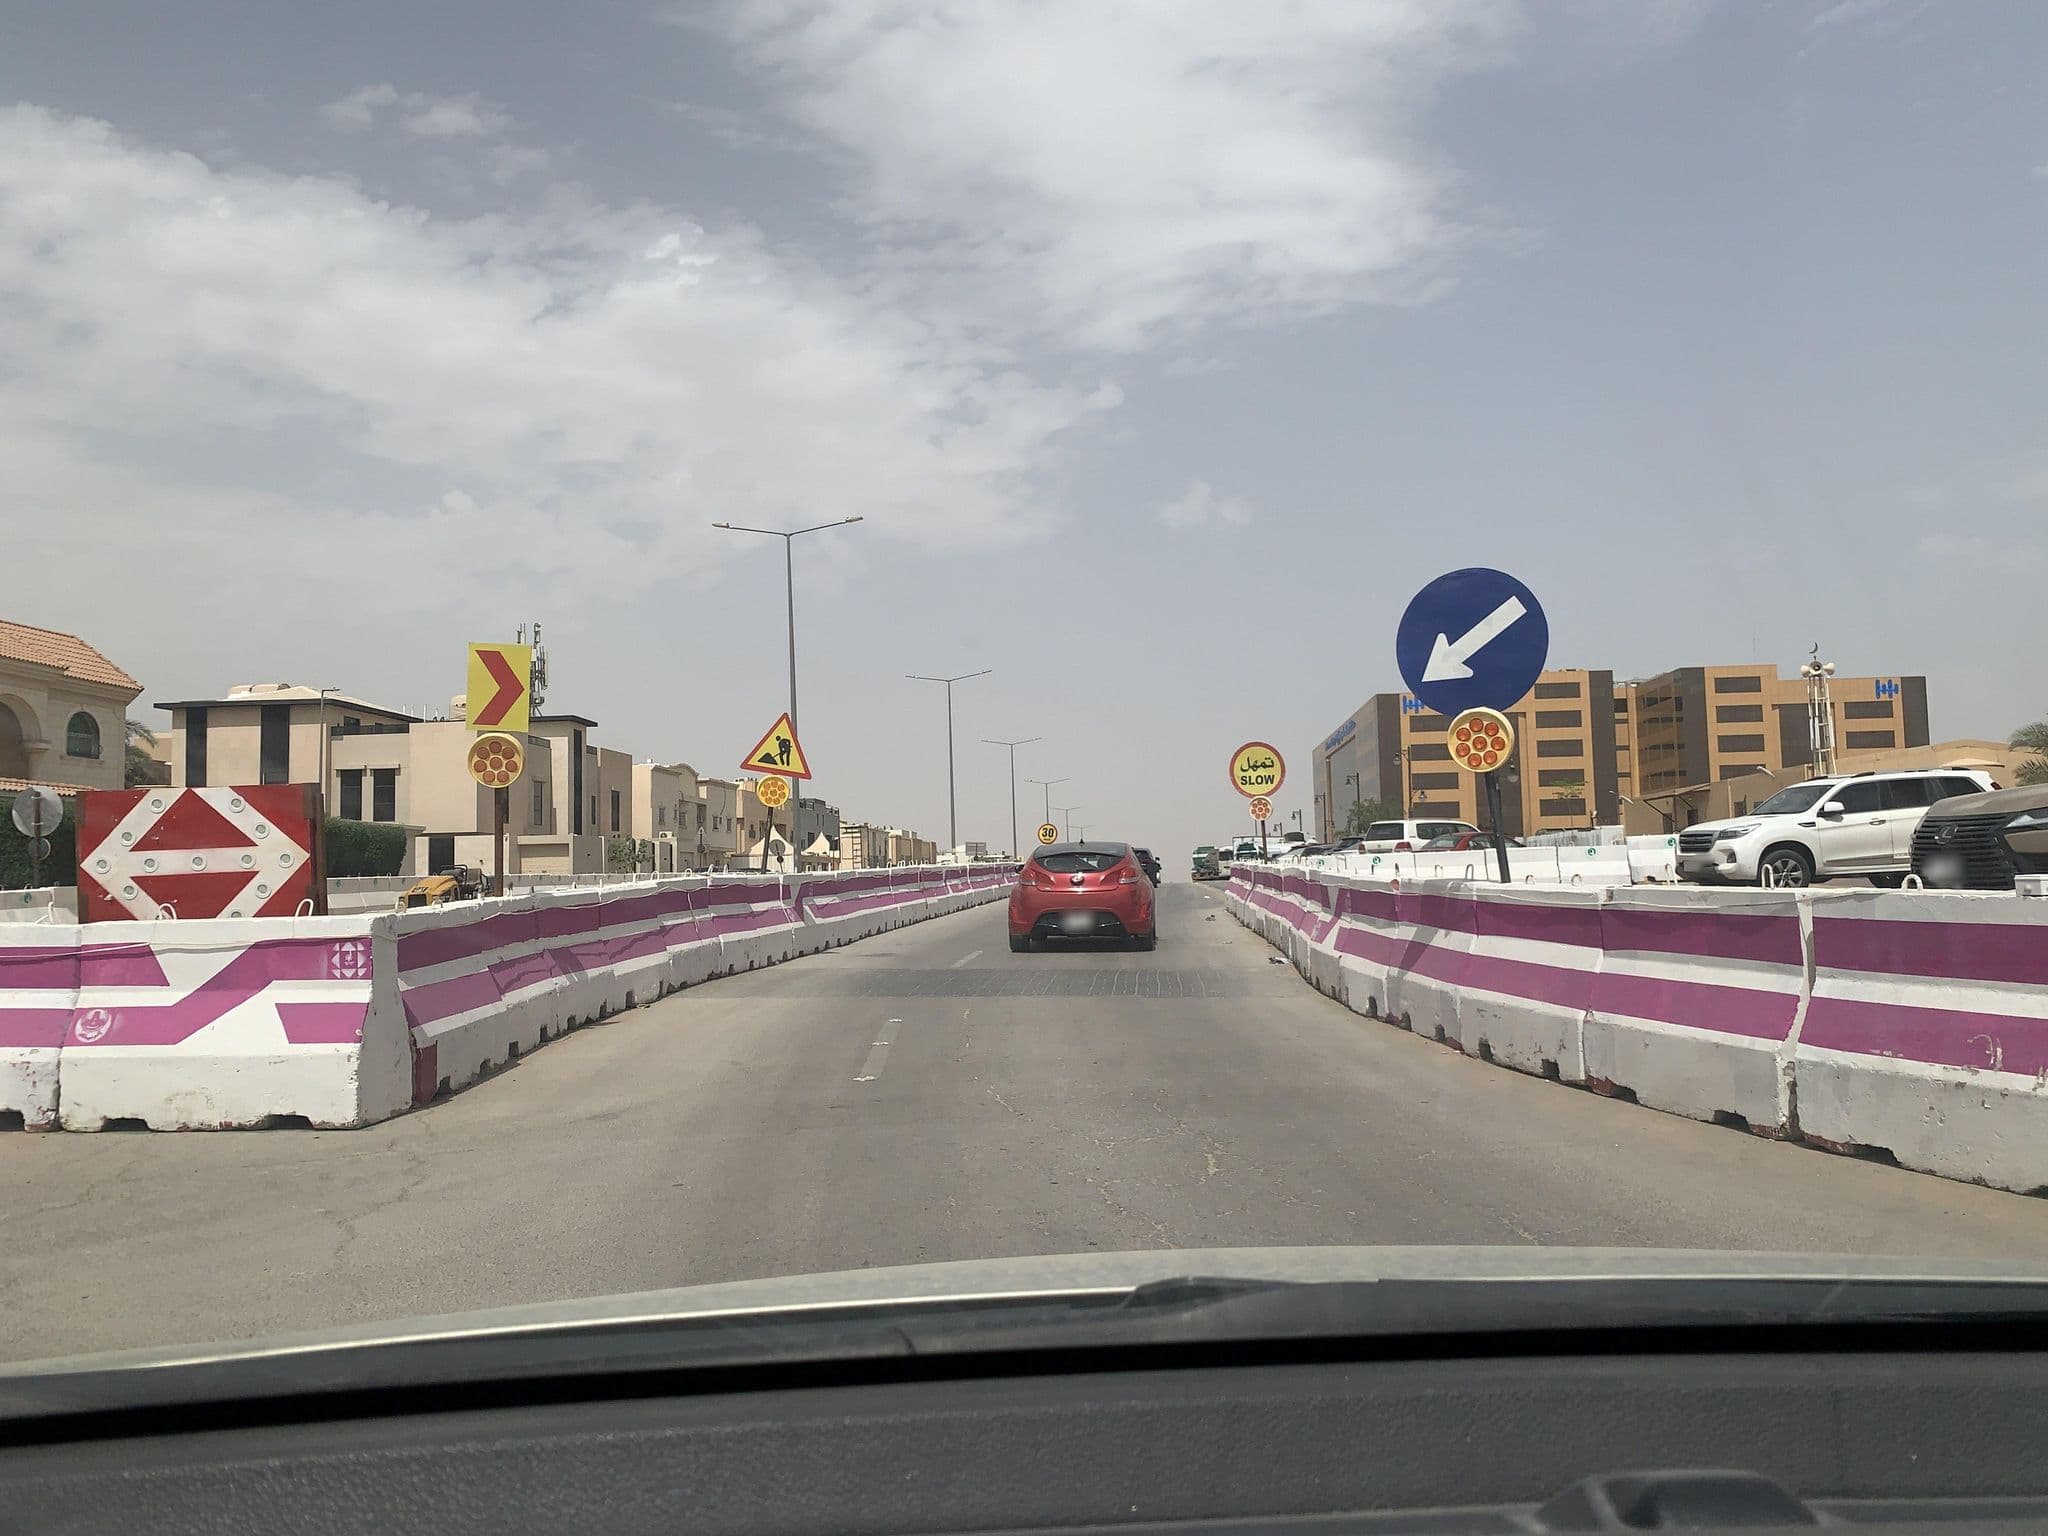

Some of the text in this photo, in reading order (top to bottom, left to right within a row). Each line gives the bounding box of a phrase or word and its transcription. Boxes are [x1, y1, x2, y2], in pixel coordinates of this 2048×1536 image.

[1240, 756, 1274, 772] تمهل
[1240, 775, 1275, 785] SLOW
[1042, 827, 1054, 838] 30
